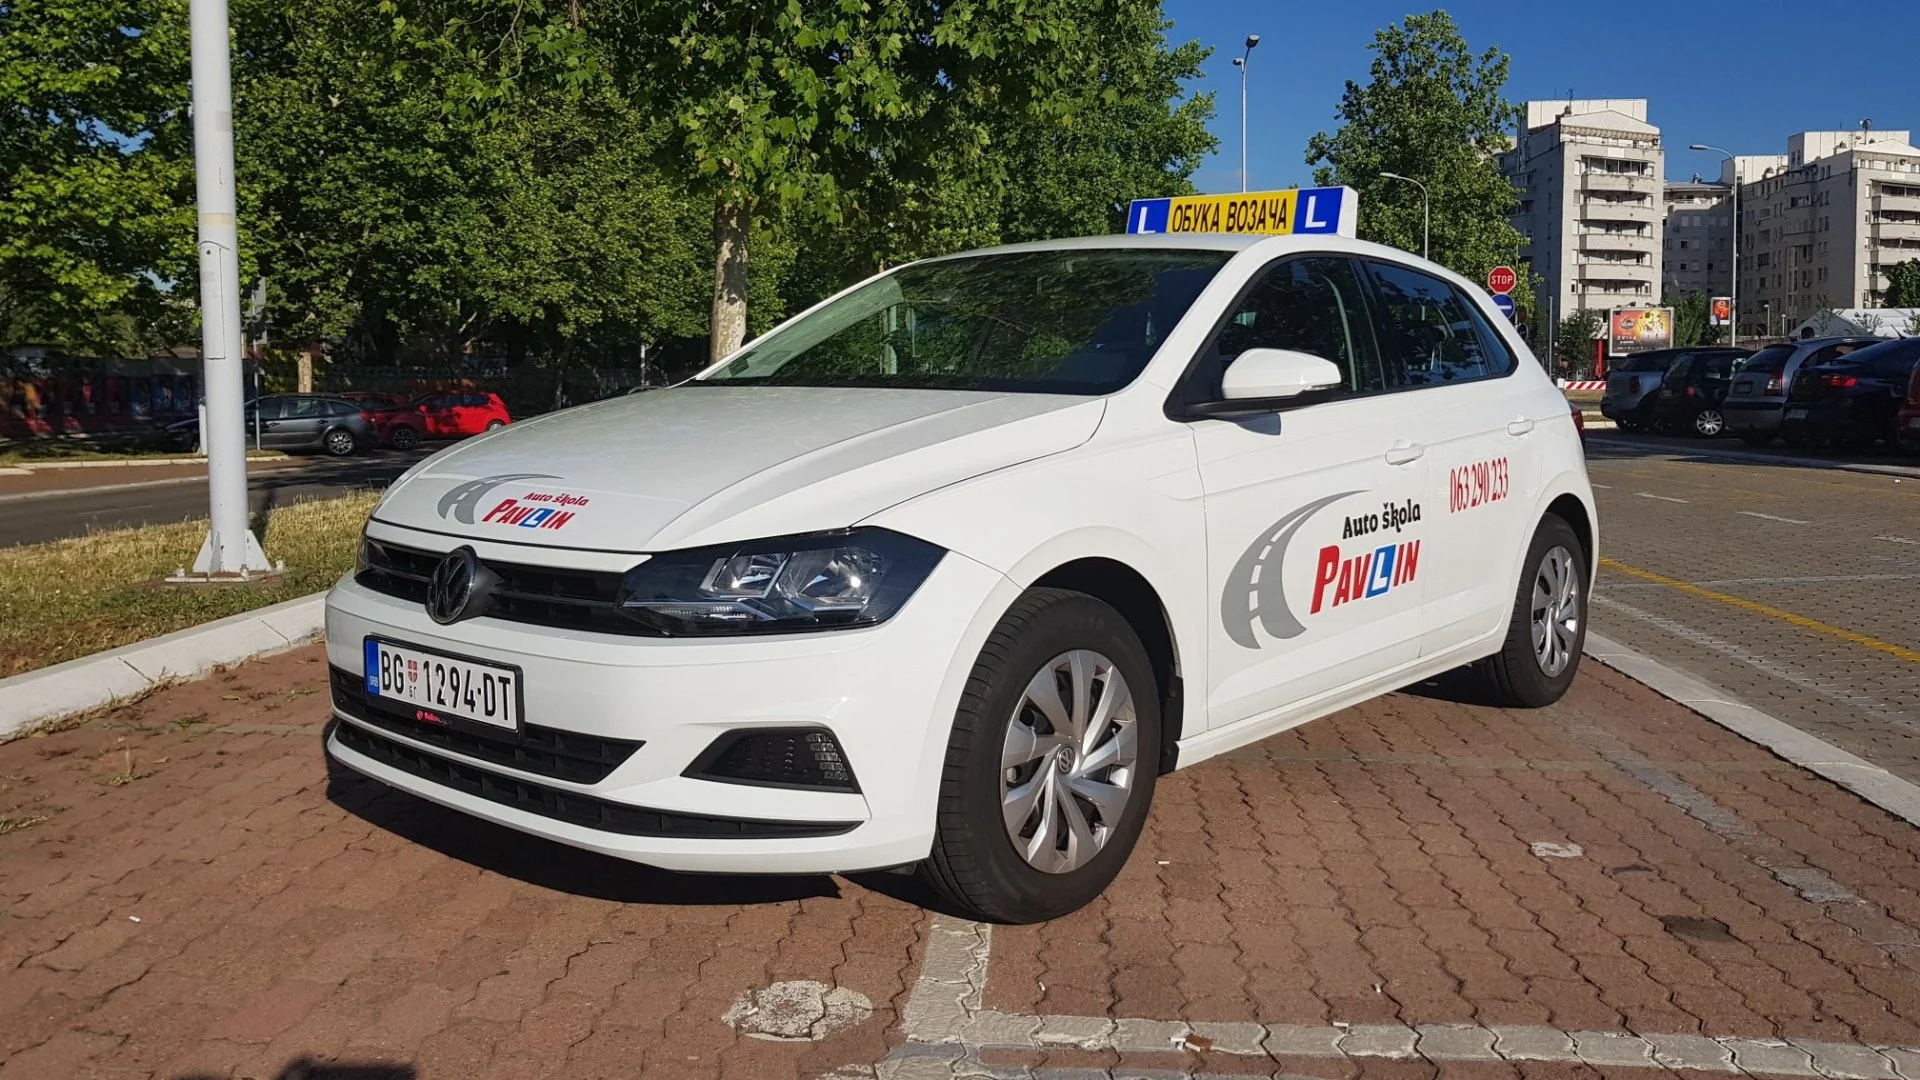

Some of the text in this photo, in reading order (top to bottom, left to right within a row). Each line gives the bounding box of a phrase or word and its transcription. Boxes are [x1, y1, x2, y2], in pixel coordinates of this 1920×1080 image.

[1137, 196, 1326, 234] L ОБУКА ВОЗАЧА L
[1490, 274, 1513, 285] STOP
[523, 492, 590, 507] Auto škola
[1450, 456, 1509, 514] 063 290 233
[1342, 498, 1421, 540] Auto škola
[381, 650, 405, 695] BG
